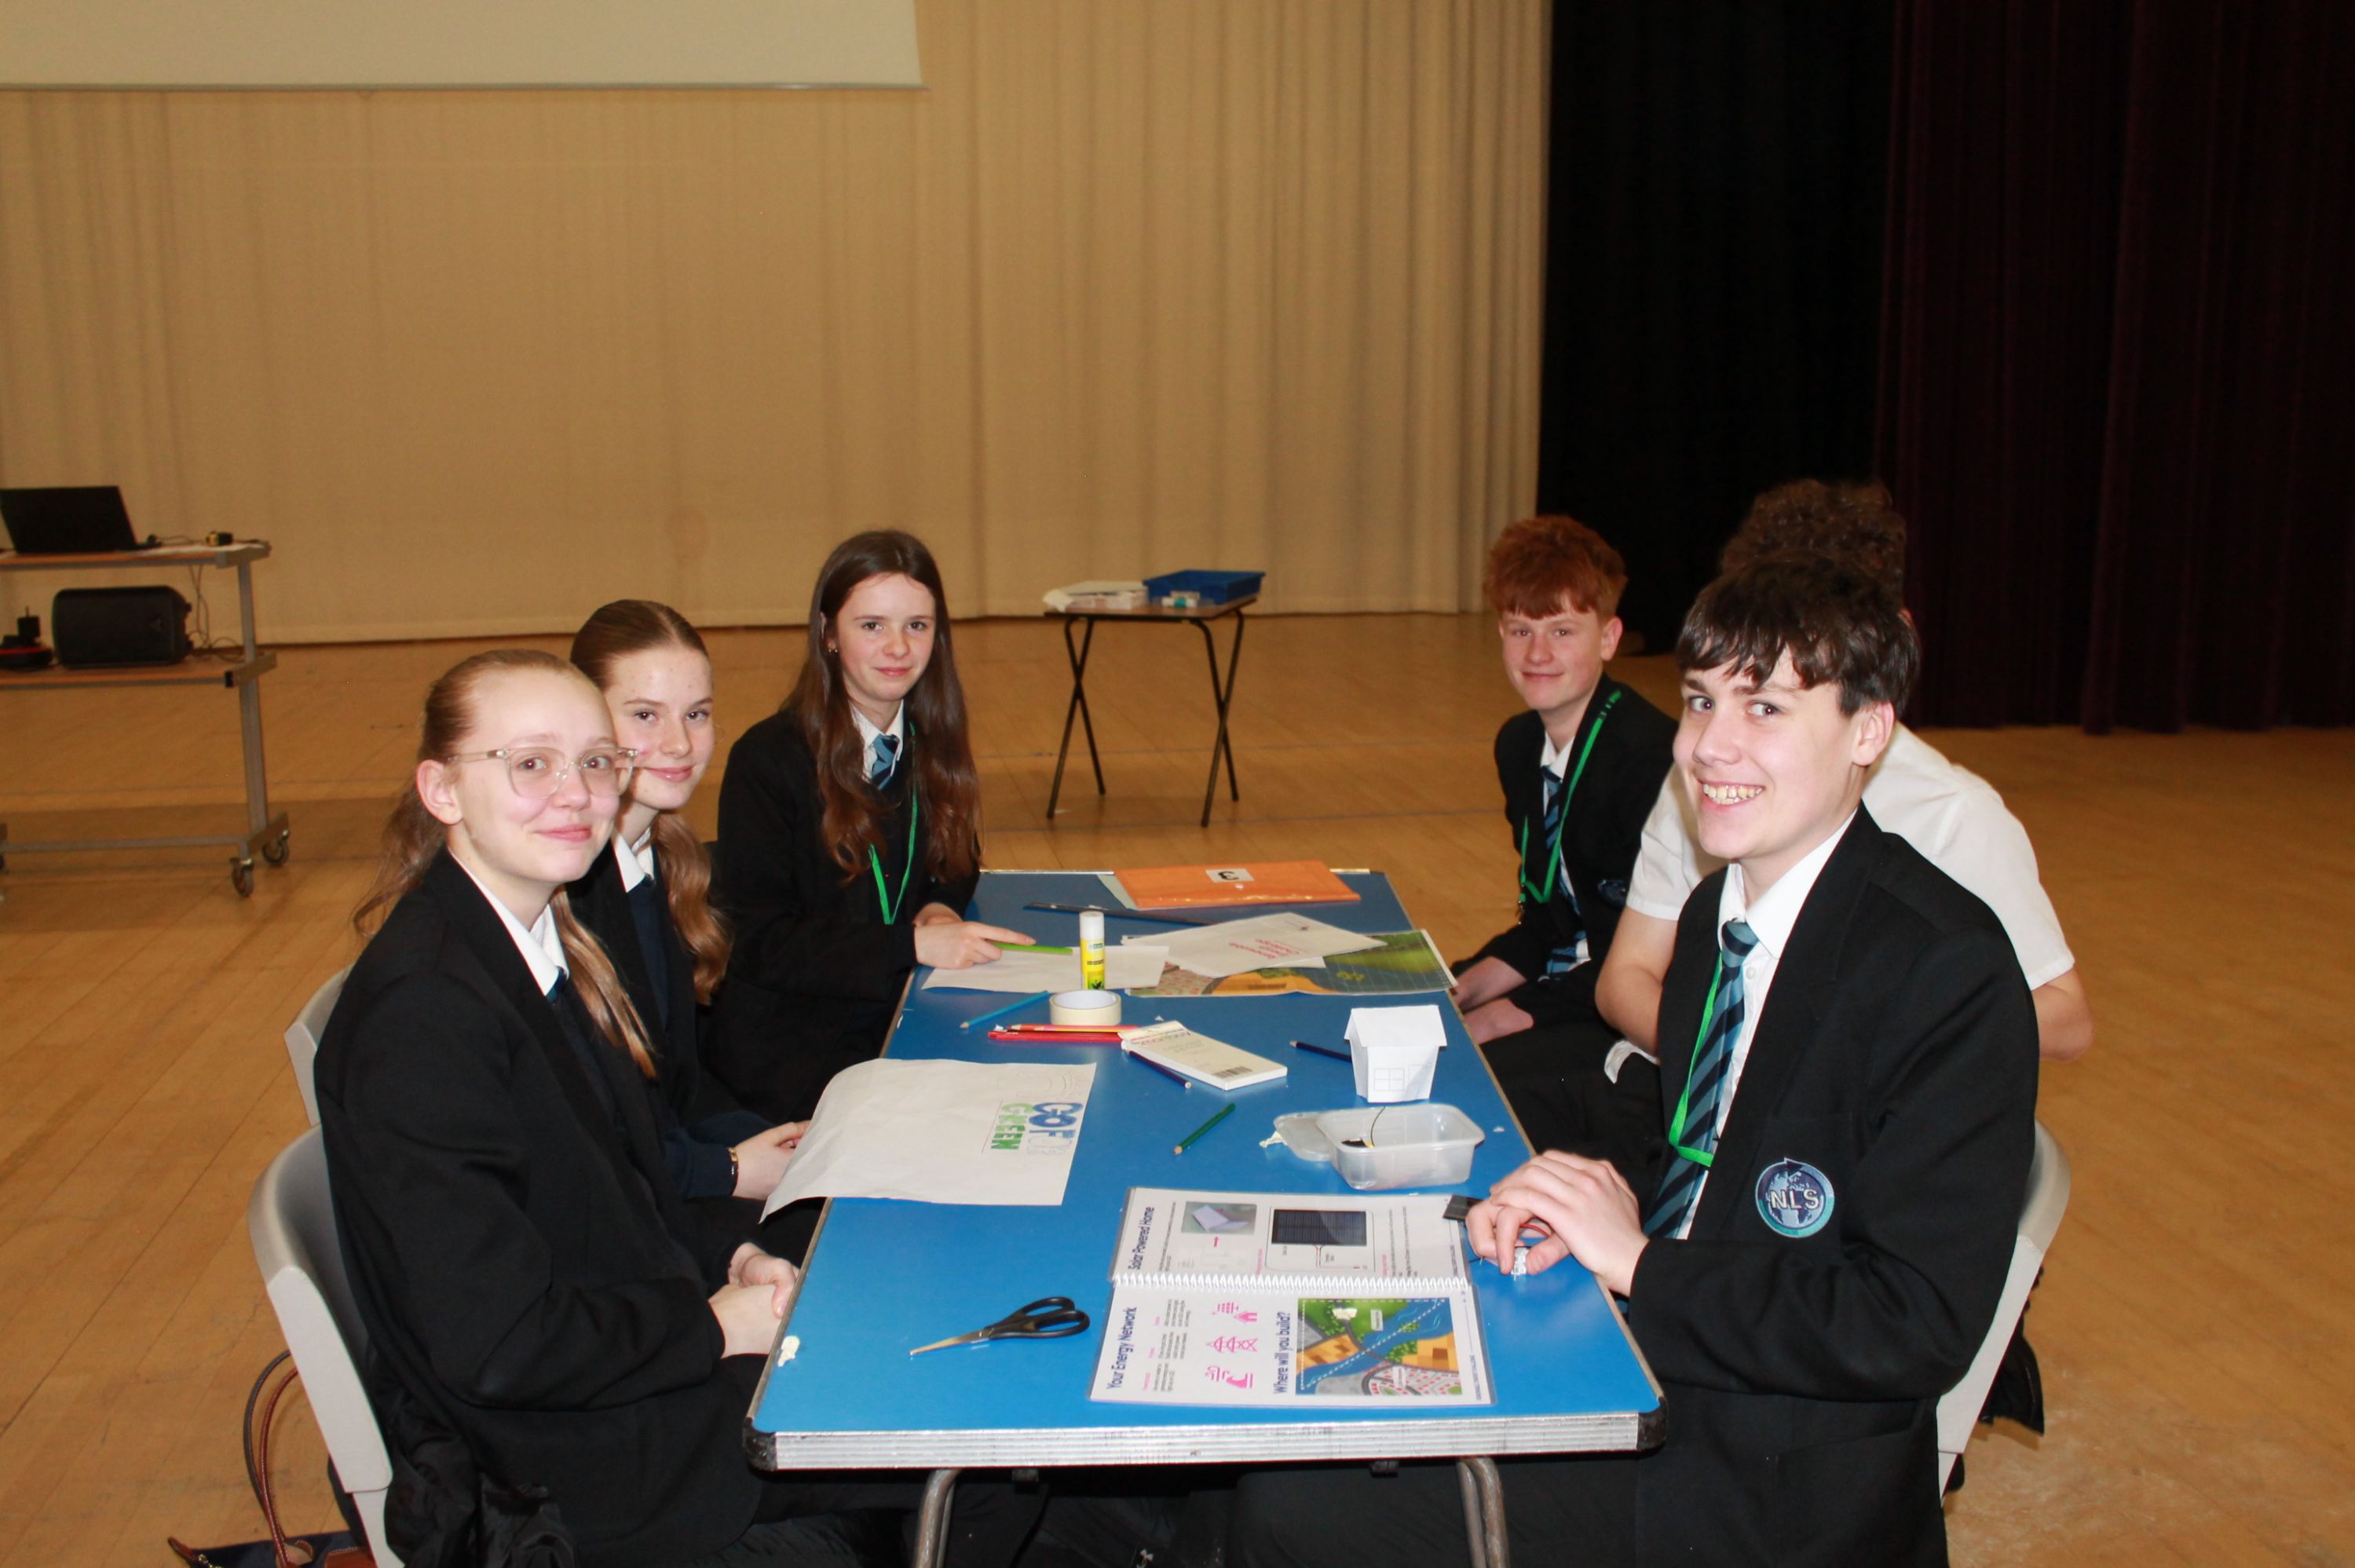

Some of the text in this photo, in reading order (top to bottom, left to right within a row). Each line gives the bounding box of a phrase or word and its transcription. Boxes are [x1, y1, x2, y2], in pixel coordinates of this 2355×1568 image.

[990, 1102, 1034, 1150] GREEN
[1029, 1102, 1084, 1128] GO
[1770, 1189, 1820, 1210] NLS
[1128, 1206, 1155, 1270] Solar Powered Home
[1106, 1307, 1137, 1389] Your Energy Network
[1273, 1311, 1293, 1394] Where will you build?
